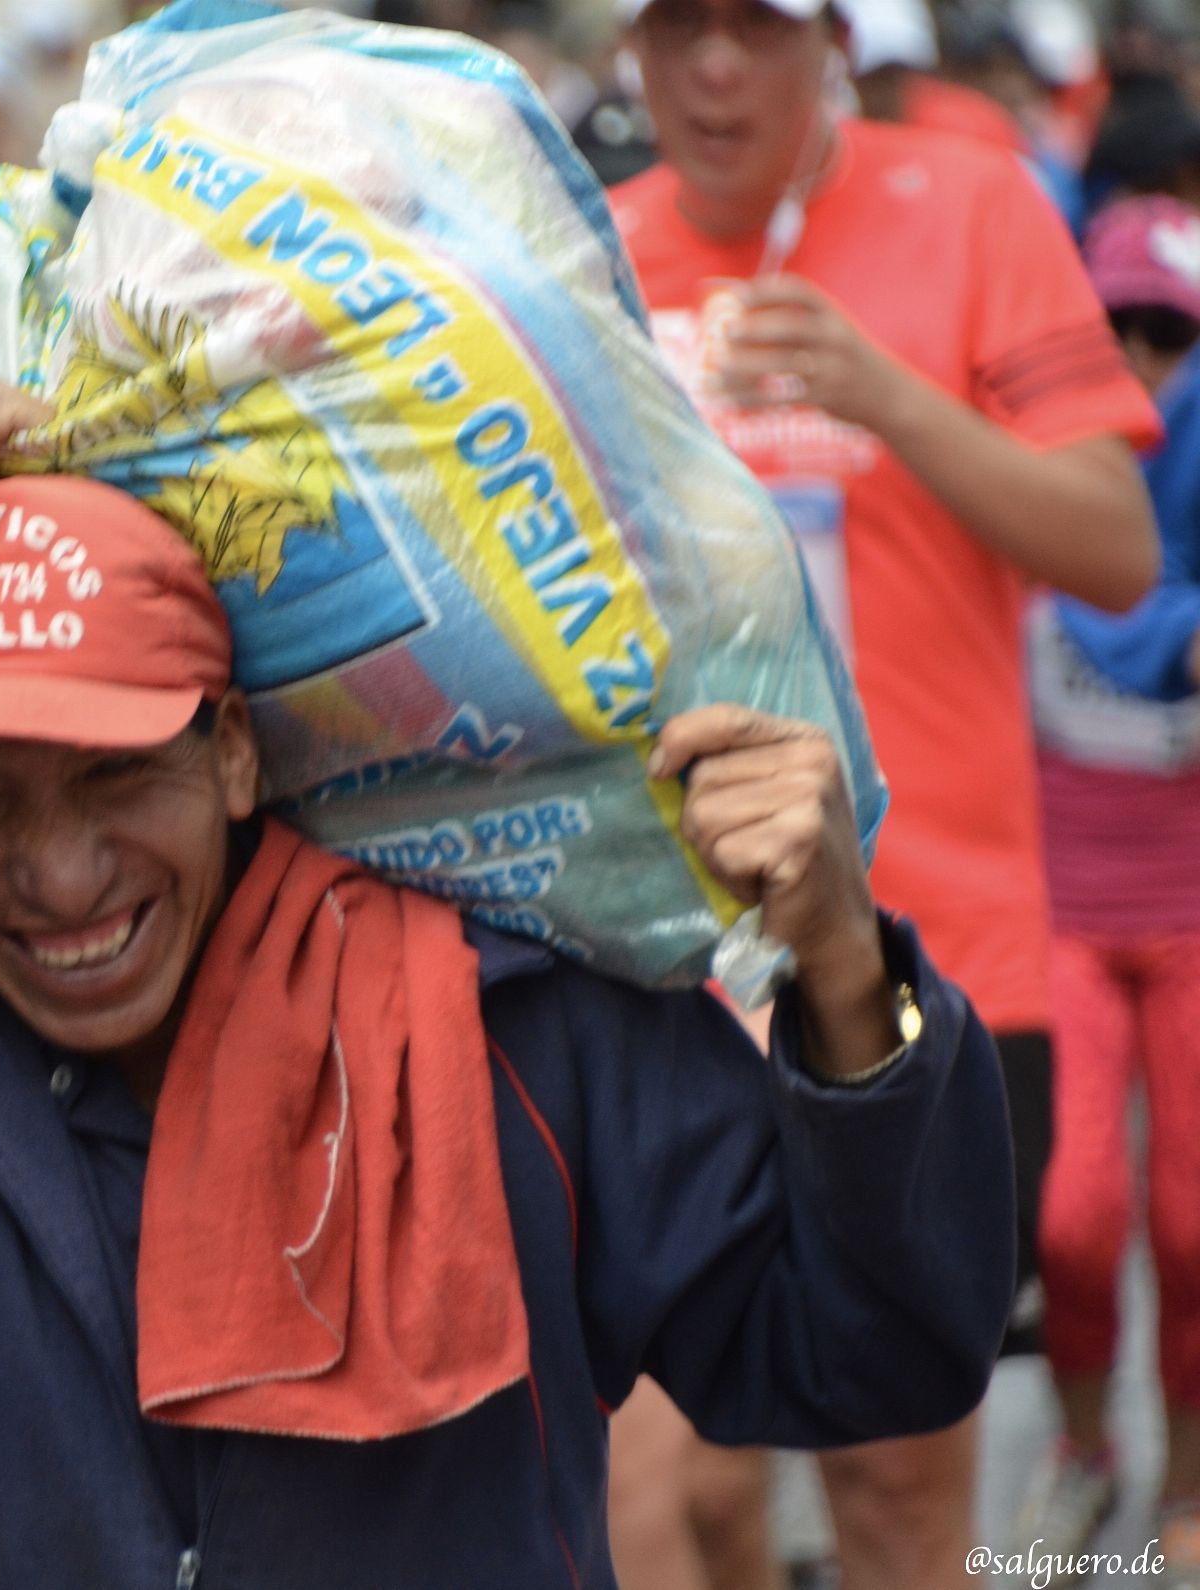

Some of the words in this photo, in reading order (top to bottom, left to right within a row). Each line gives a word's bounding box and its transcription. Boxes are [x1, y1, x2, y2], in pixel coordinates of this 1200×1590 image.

[242, 186, 458, 358] LEON
[454, 400, 618, 650] VIEJO
[471, 795, 590, 856] POR:
